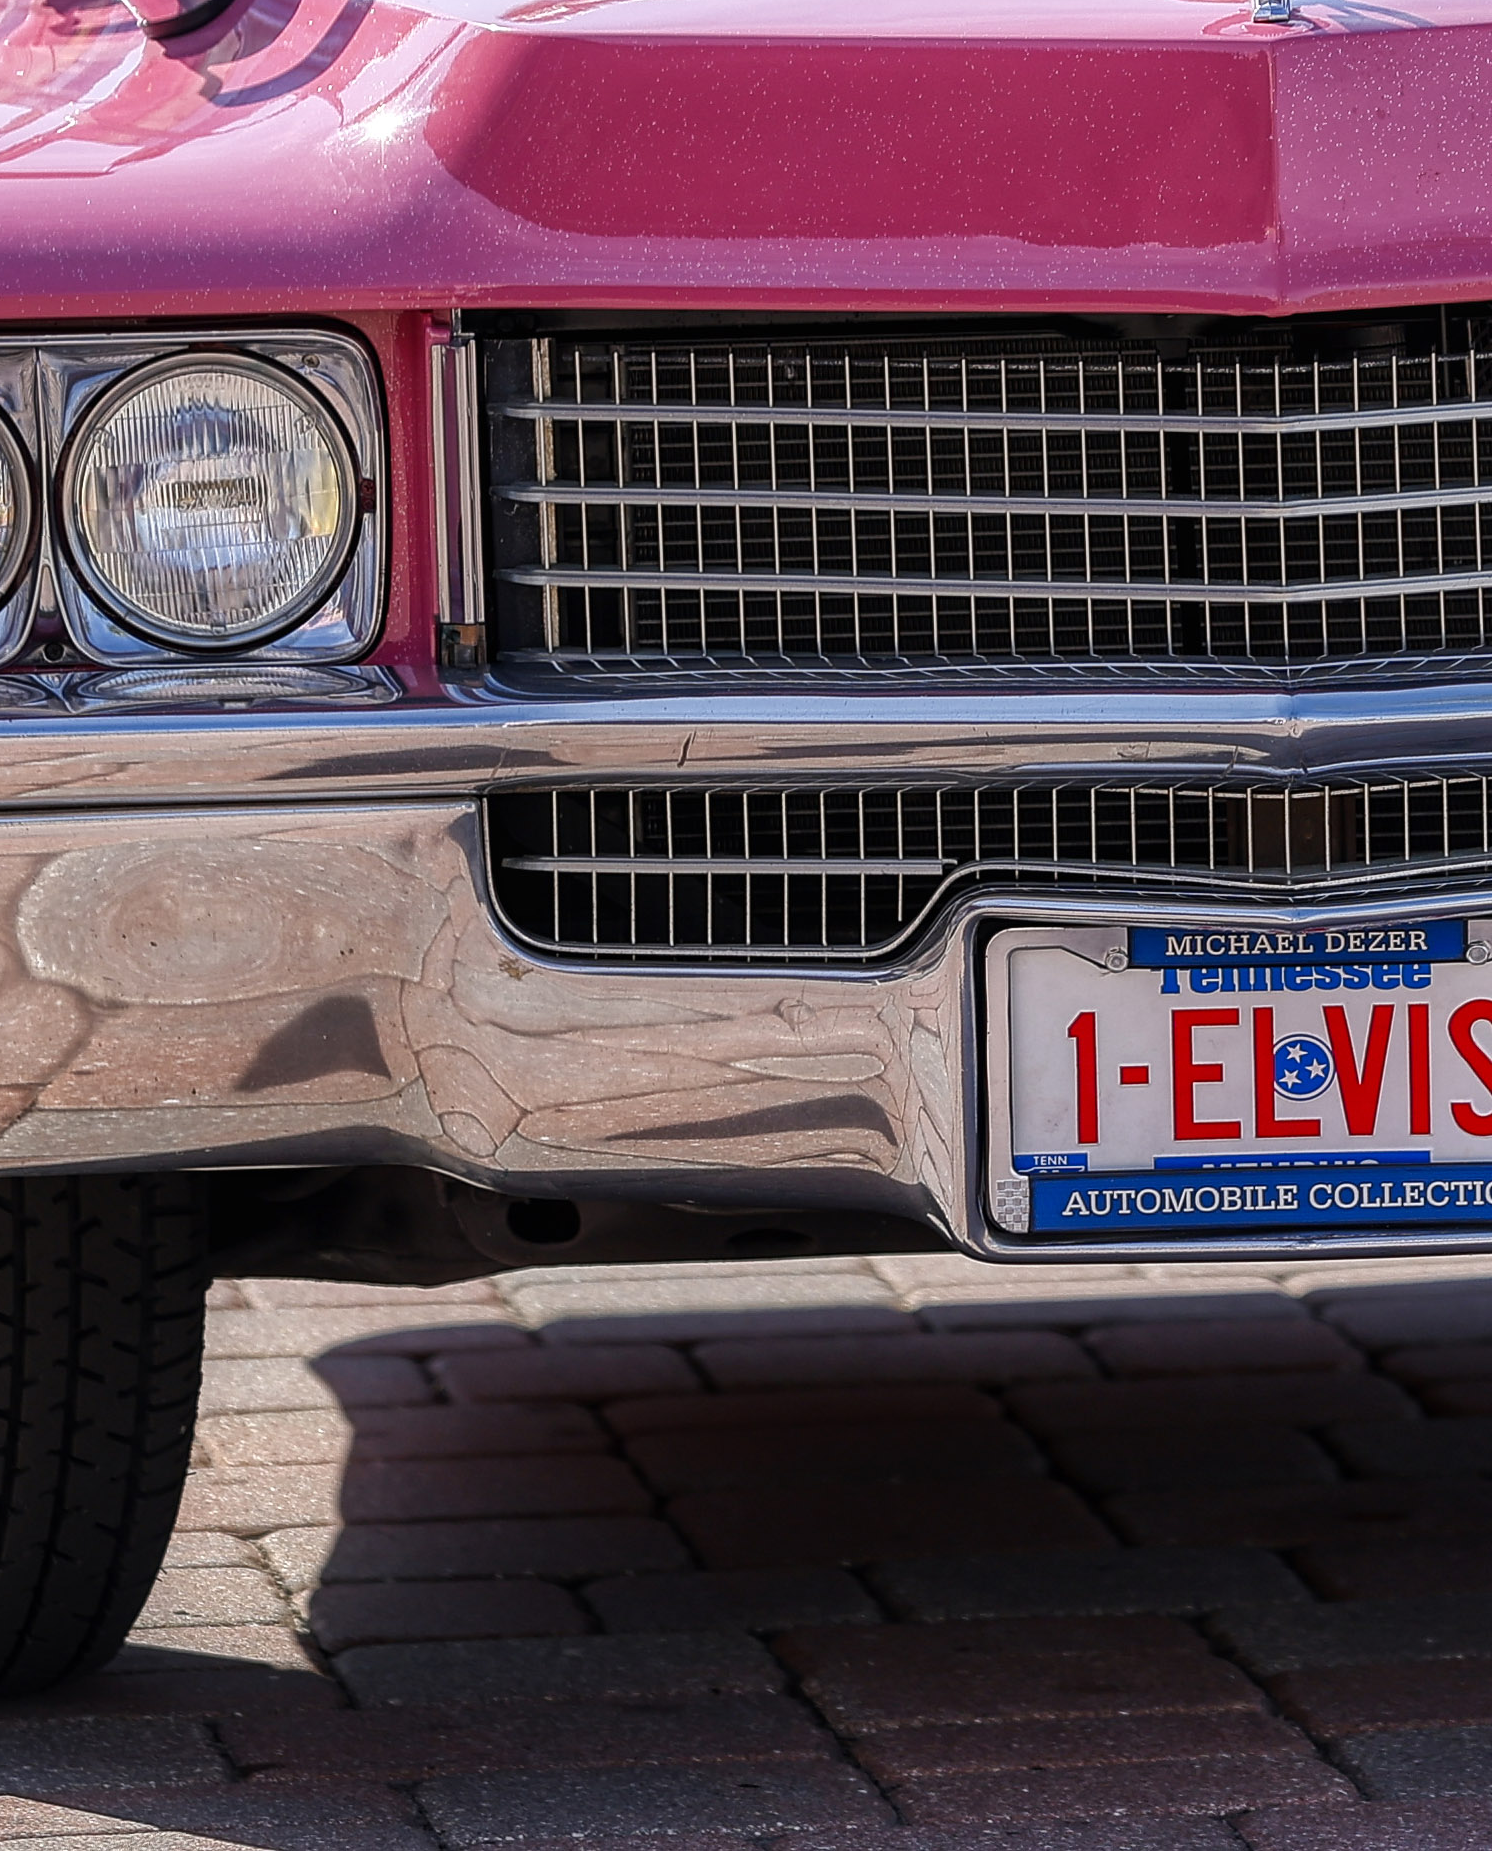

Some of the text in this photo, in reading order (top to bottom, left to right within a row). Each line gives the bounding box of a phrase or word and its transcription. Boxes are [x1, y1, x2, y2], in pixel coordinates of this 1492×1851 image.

[1165, 930, 1428, 957] MICHAEL DEZER
[1033, 1155, 1068, 1166] TENN
[1061, 1184, 1299, 1216] AUTOMOBILE
